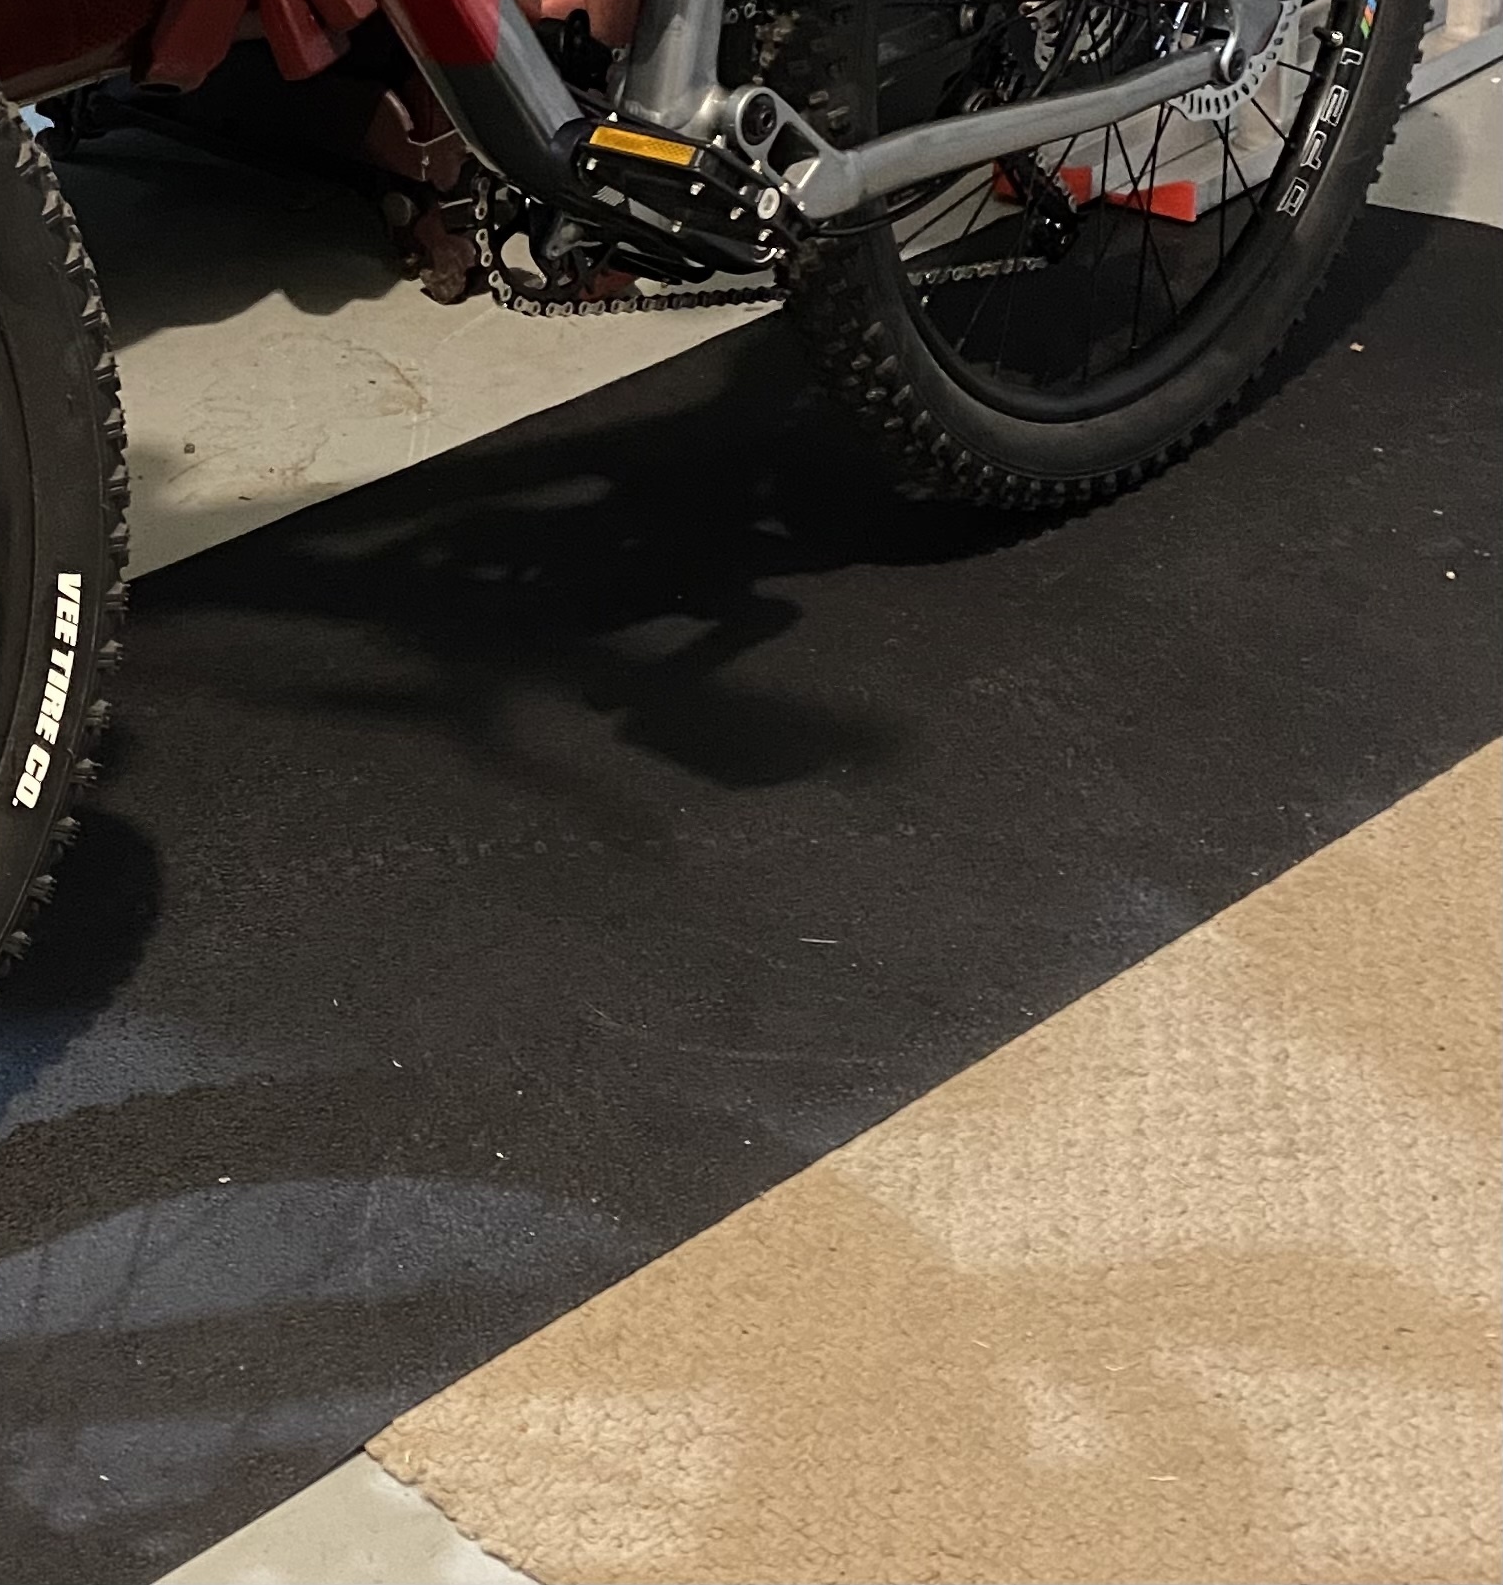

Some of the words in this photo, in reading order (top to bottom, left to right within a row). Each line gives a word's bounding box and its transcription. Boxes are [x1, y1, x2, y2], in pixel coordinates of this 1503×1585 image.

[54, 572, 82, 647] VEE
[35, 648, 75, 745] TIRE
[12, 743, 51, 809] CO.
